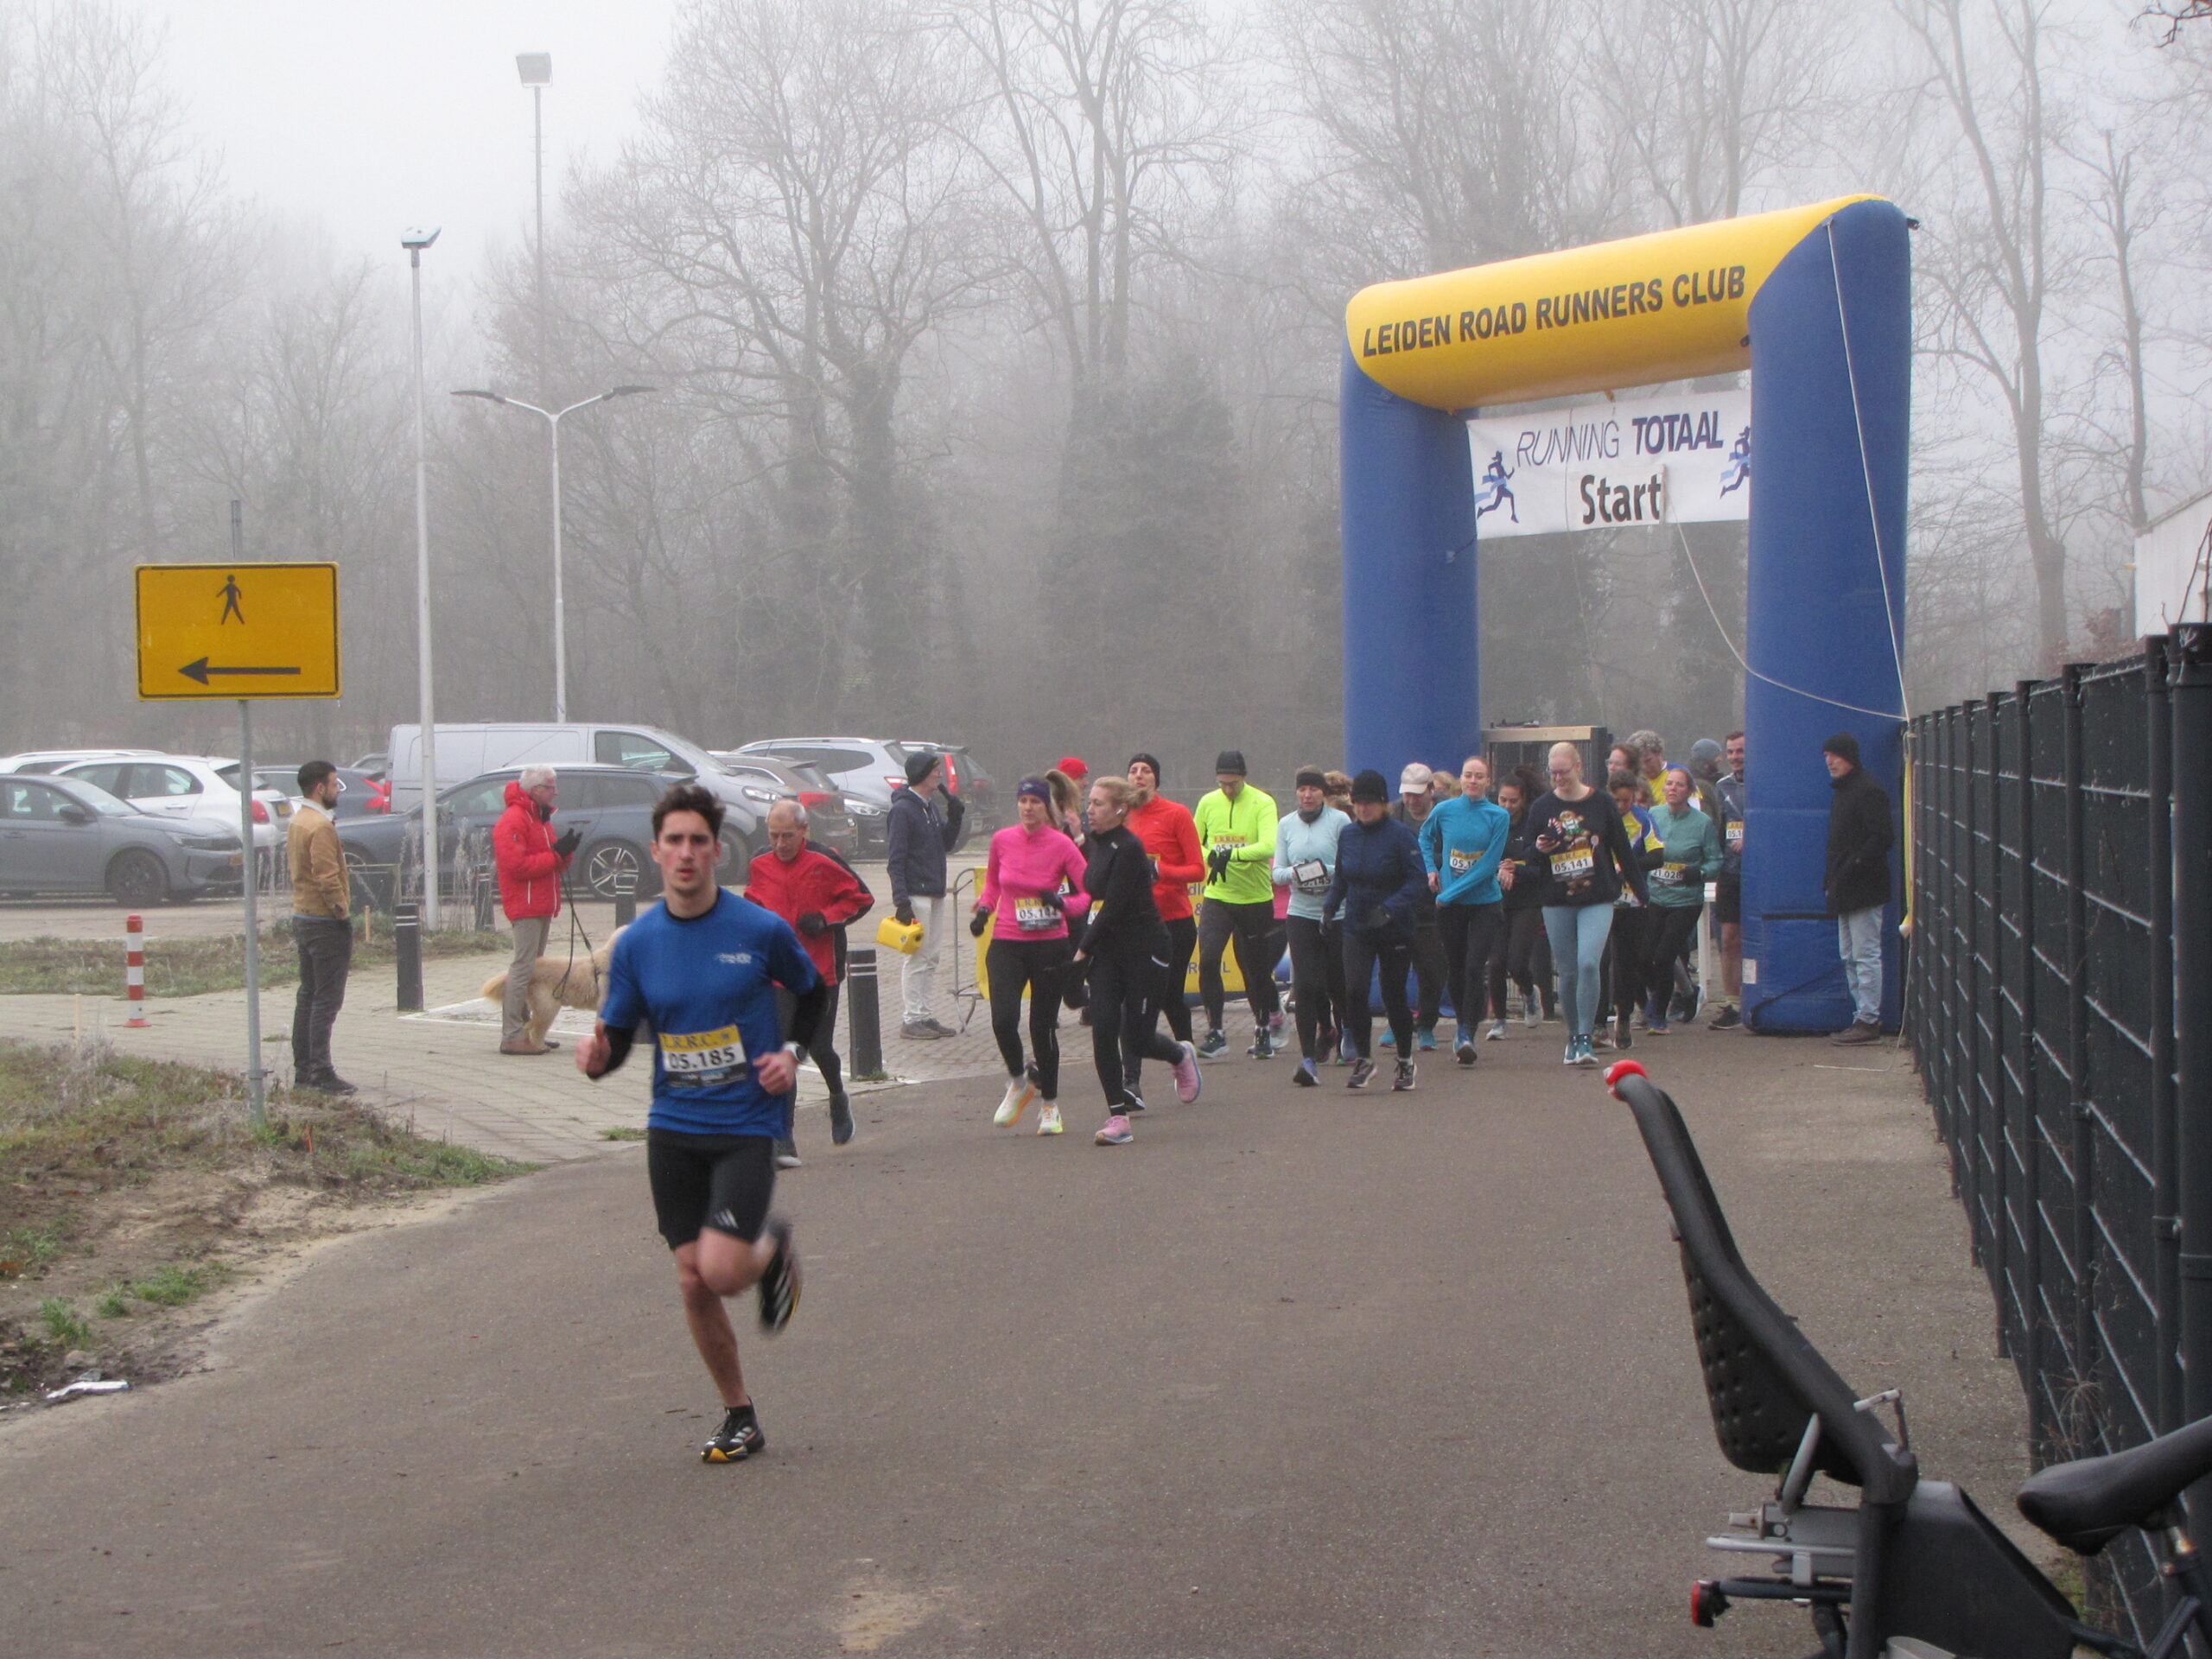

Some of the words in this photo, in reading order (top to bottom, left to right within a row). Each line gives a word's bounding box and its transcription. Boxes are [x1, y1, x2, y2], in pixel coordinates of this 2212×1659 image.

[1363, 315, 1451, 357] LEIDEN
[1459, 302, 1527, 342] ROAD
[1535, 278, 1663, 330] RUNNERS
[1672, 265, 1745, 308] CLUB
[1516, 420, 1619, 467] RUNNING
[1632, 410, 1724, 455] TOTAAL
[1580, 474, 1662, 524] Start
[1554, 858, 1588, 873] 05.141
[668, 1046, 735, 1070] 05.185
